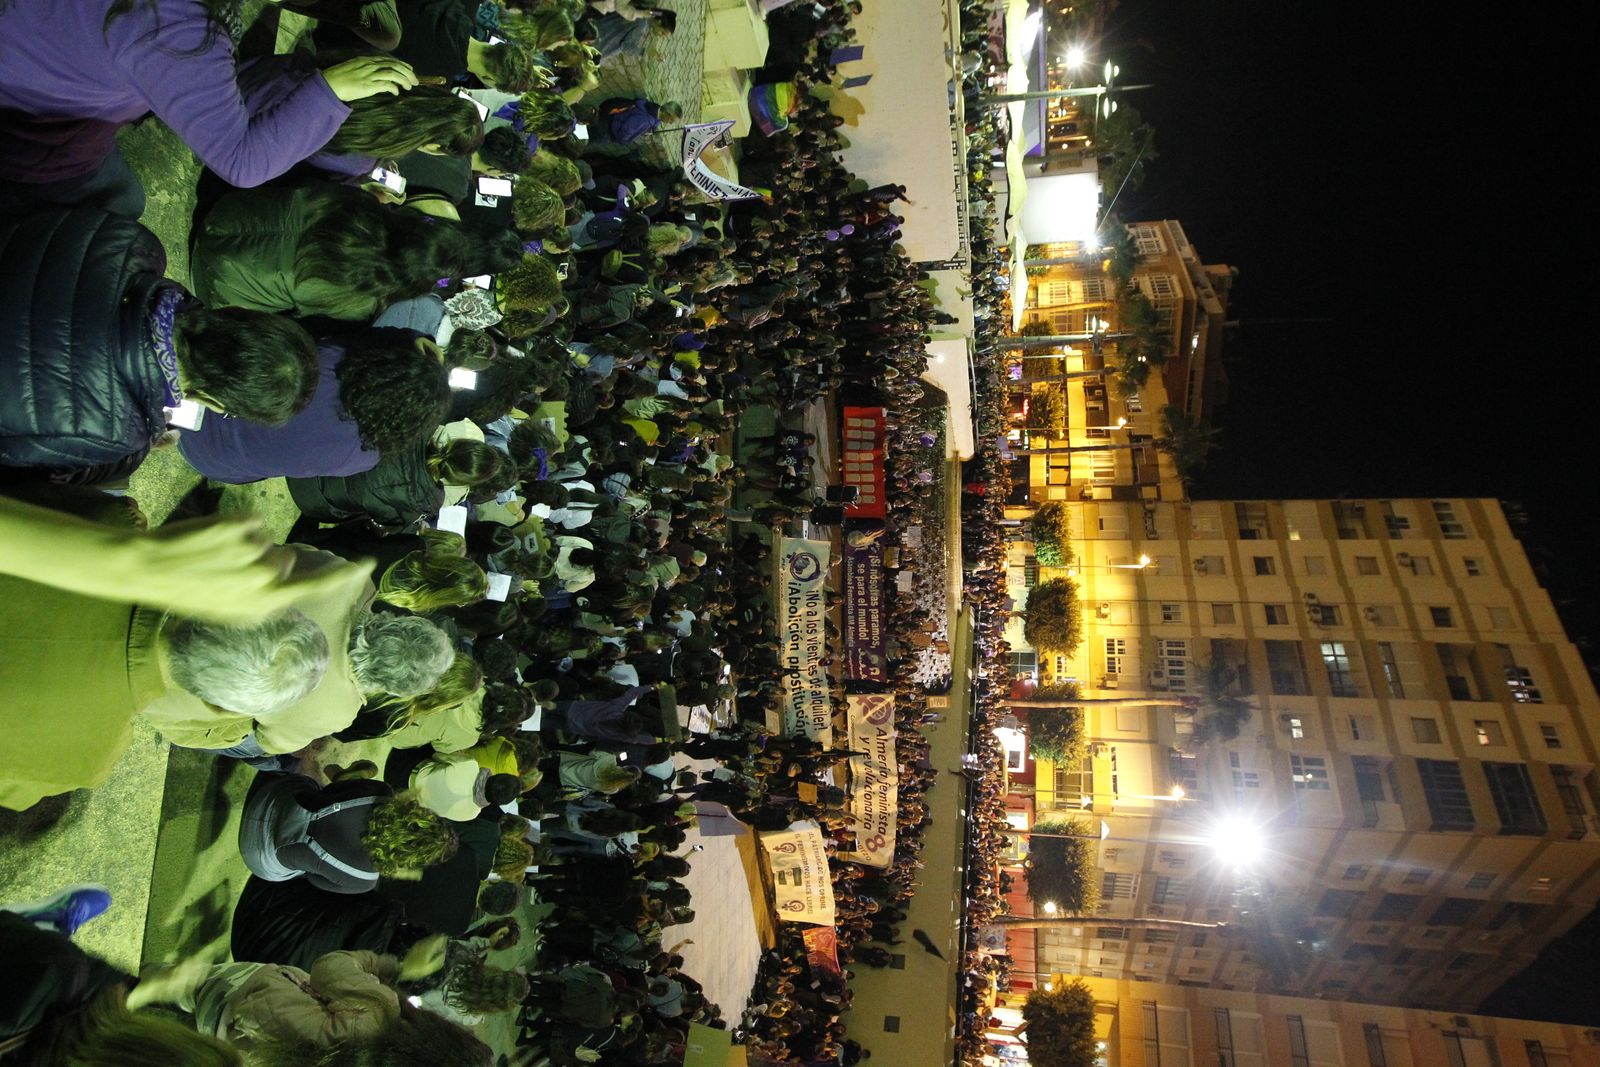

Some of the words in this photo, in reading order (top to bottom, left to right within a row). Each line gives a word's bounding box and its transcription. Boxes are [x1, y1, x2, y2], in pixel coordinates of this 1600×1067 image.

[858, 563, 866, 574] se
[868, 555, 880, 566] ¡Si
[806, 590, 820, 606] ¡No
[855, 576, 867, 596] para
[870, 569, 880, 606] nosotras
[858, 598, 868, 606] el
[788, 582, 803, 650] ¡Abolición
[806, 620, 819, 634] los
[858, 608, 869, 640] mundo!
[869, 608, 880, 648] paramos,
[806, 638, 822, 676] vientres
[810, 678, 823, 689] de
[808, 691, 828, 730] alquiler!
[860, 736, 870, 744] y
[876, 727, 890, 778] Almería
[862, 748, 876, 830] revolucionaria
[876, 779, 890, 835] feminista
[865, 834, 886, 852] 8
